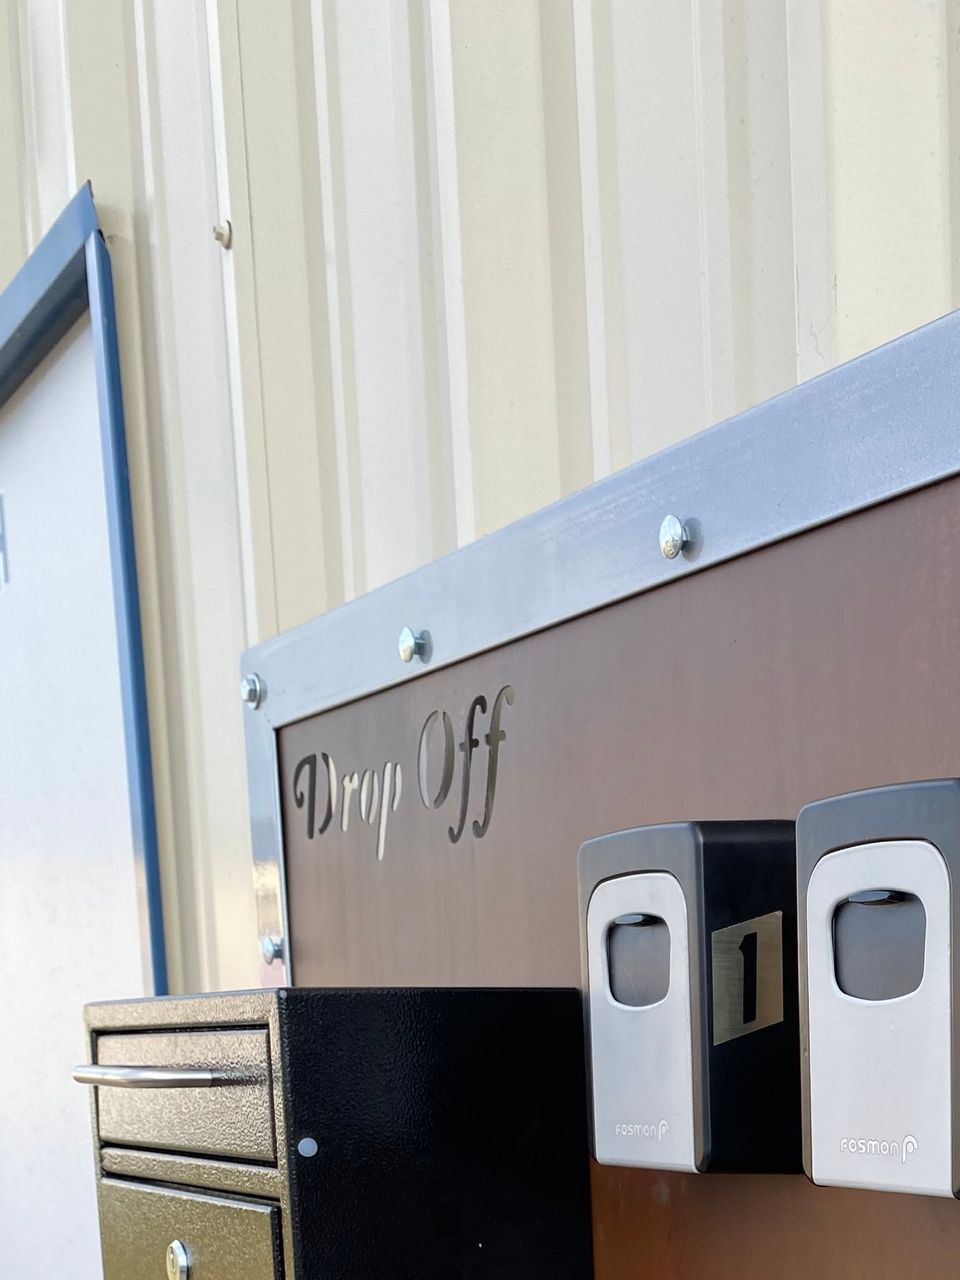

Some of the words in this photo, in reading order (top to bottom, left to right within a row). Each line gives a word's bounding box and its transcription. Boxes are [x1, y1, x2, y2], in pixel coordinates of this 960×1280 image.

[293, 752, 402, 861] Drop
[417, 685, 515, 844] Off
[737, 931, 758, 1025] 1
